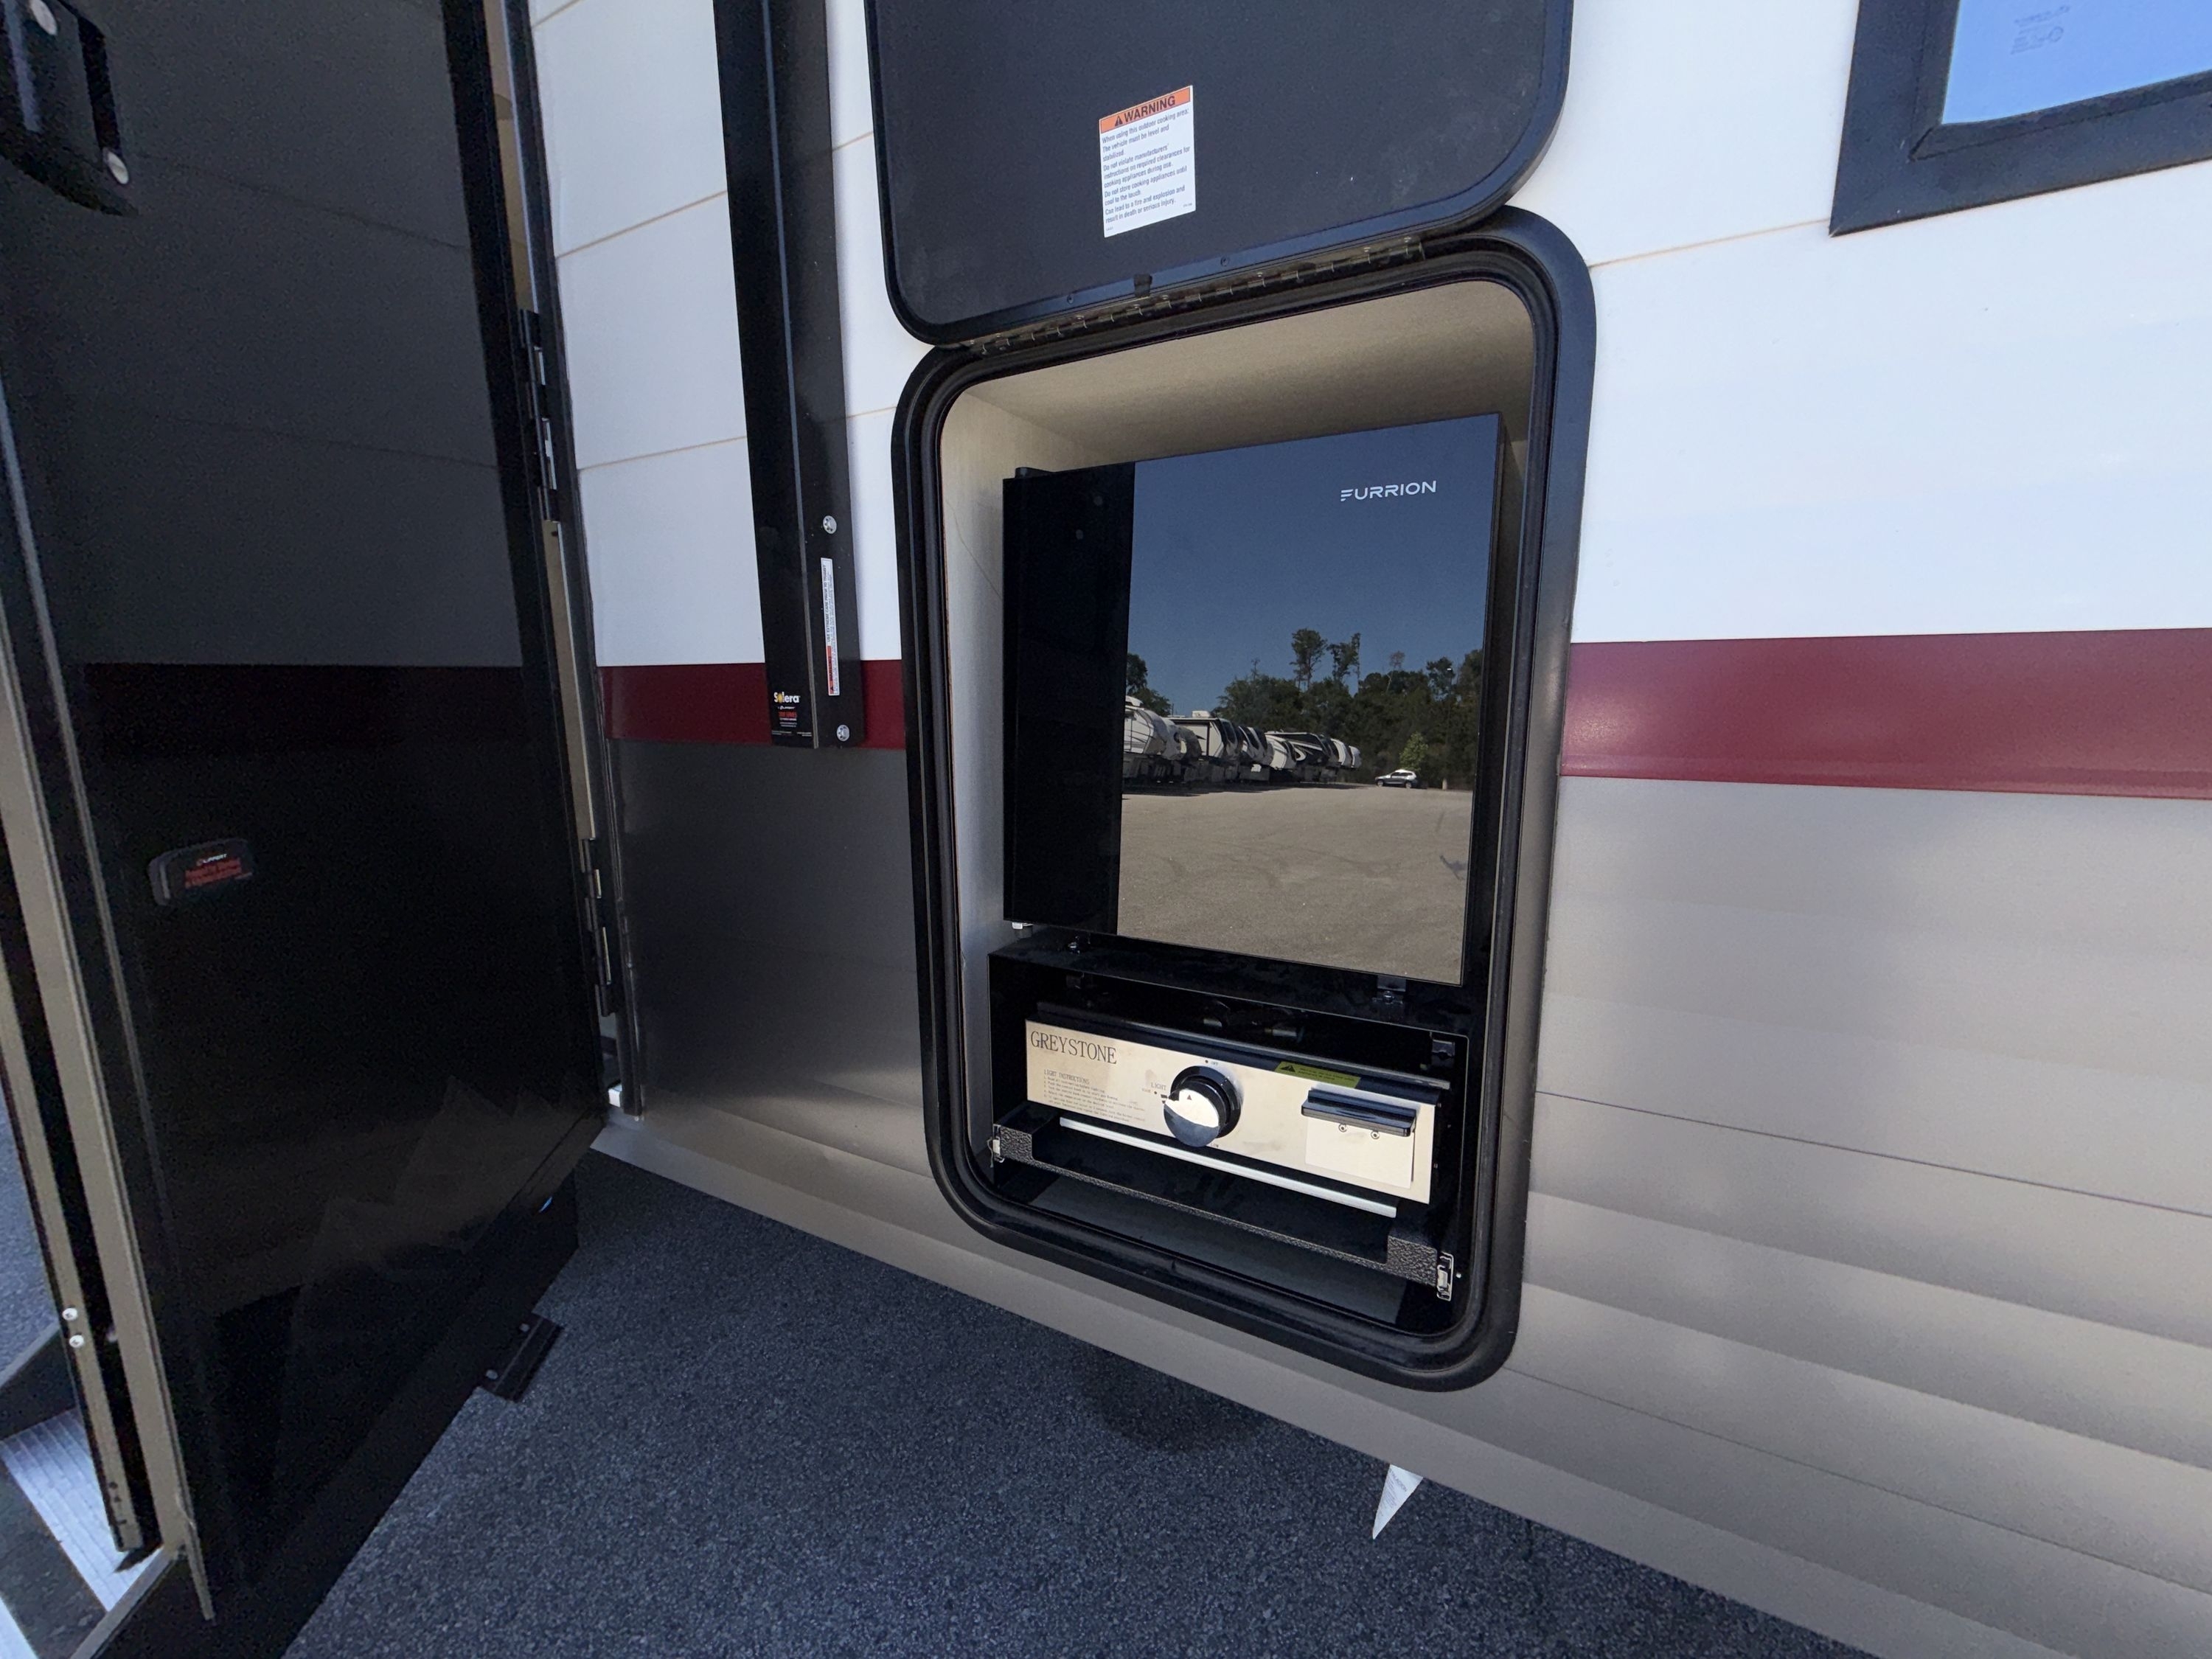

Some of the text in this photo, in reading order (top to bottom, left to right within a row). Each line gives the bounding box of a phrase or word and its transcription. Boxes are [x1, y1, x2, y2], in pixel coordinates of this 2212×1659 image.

[1124, 95, 1175, 122] WARNING
[1102, 135, 1115, 143] When
[1116, 130, 1128, 139] using
[1138, 120, 1156, 131] outdoor
[1157, 113, 1175, 124] cooking
[1111, 139, 1127, 150] vehicle
[1128, 134, 1140, 143] must
[1147, 128, 1159, 136] level
[1160, 124, 1169, 133] and
[1118, 156, 1133, 166] violate
[1136, 157, 1156, 168] required
[1157, 149, 1182, 161] clearances
[1104, 178, 1121, 188] cooking
[1121, 170, 1146, 182] appliances
[1147, 164, 1162, 174] during
[1131, 178, 1150, 189] cooking
[1150, 170, 1175, 183] appliances
[1176, 165, 1187, 174] until
[1105, 198, 1114, 206] cool
[1143, 195, 1152, 204] and
[1152, 189, 1175, 200] explosion
[1176, 184, 1185, 193] and
[1105, 215, 1118, 223] result
[1124, 209, 1136, 218] death
[1143, 202, 1160, 212] serious
[1340, 480, 1436, 501] FURRION
[773, 692, 799, 703] Solera
[1031, 1031, 1117, 1064] GREYSTONE
[1150, 1082, 1166, 1091] LIGHT
